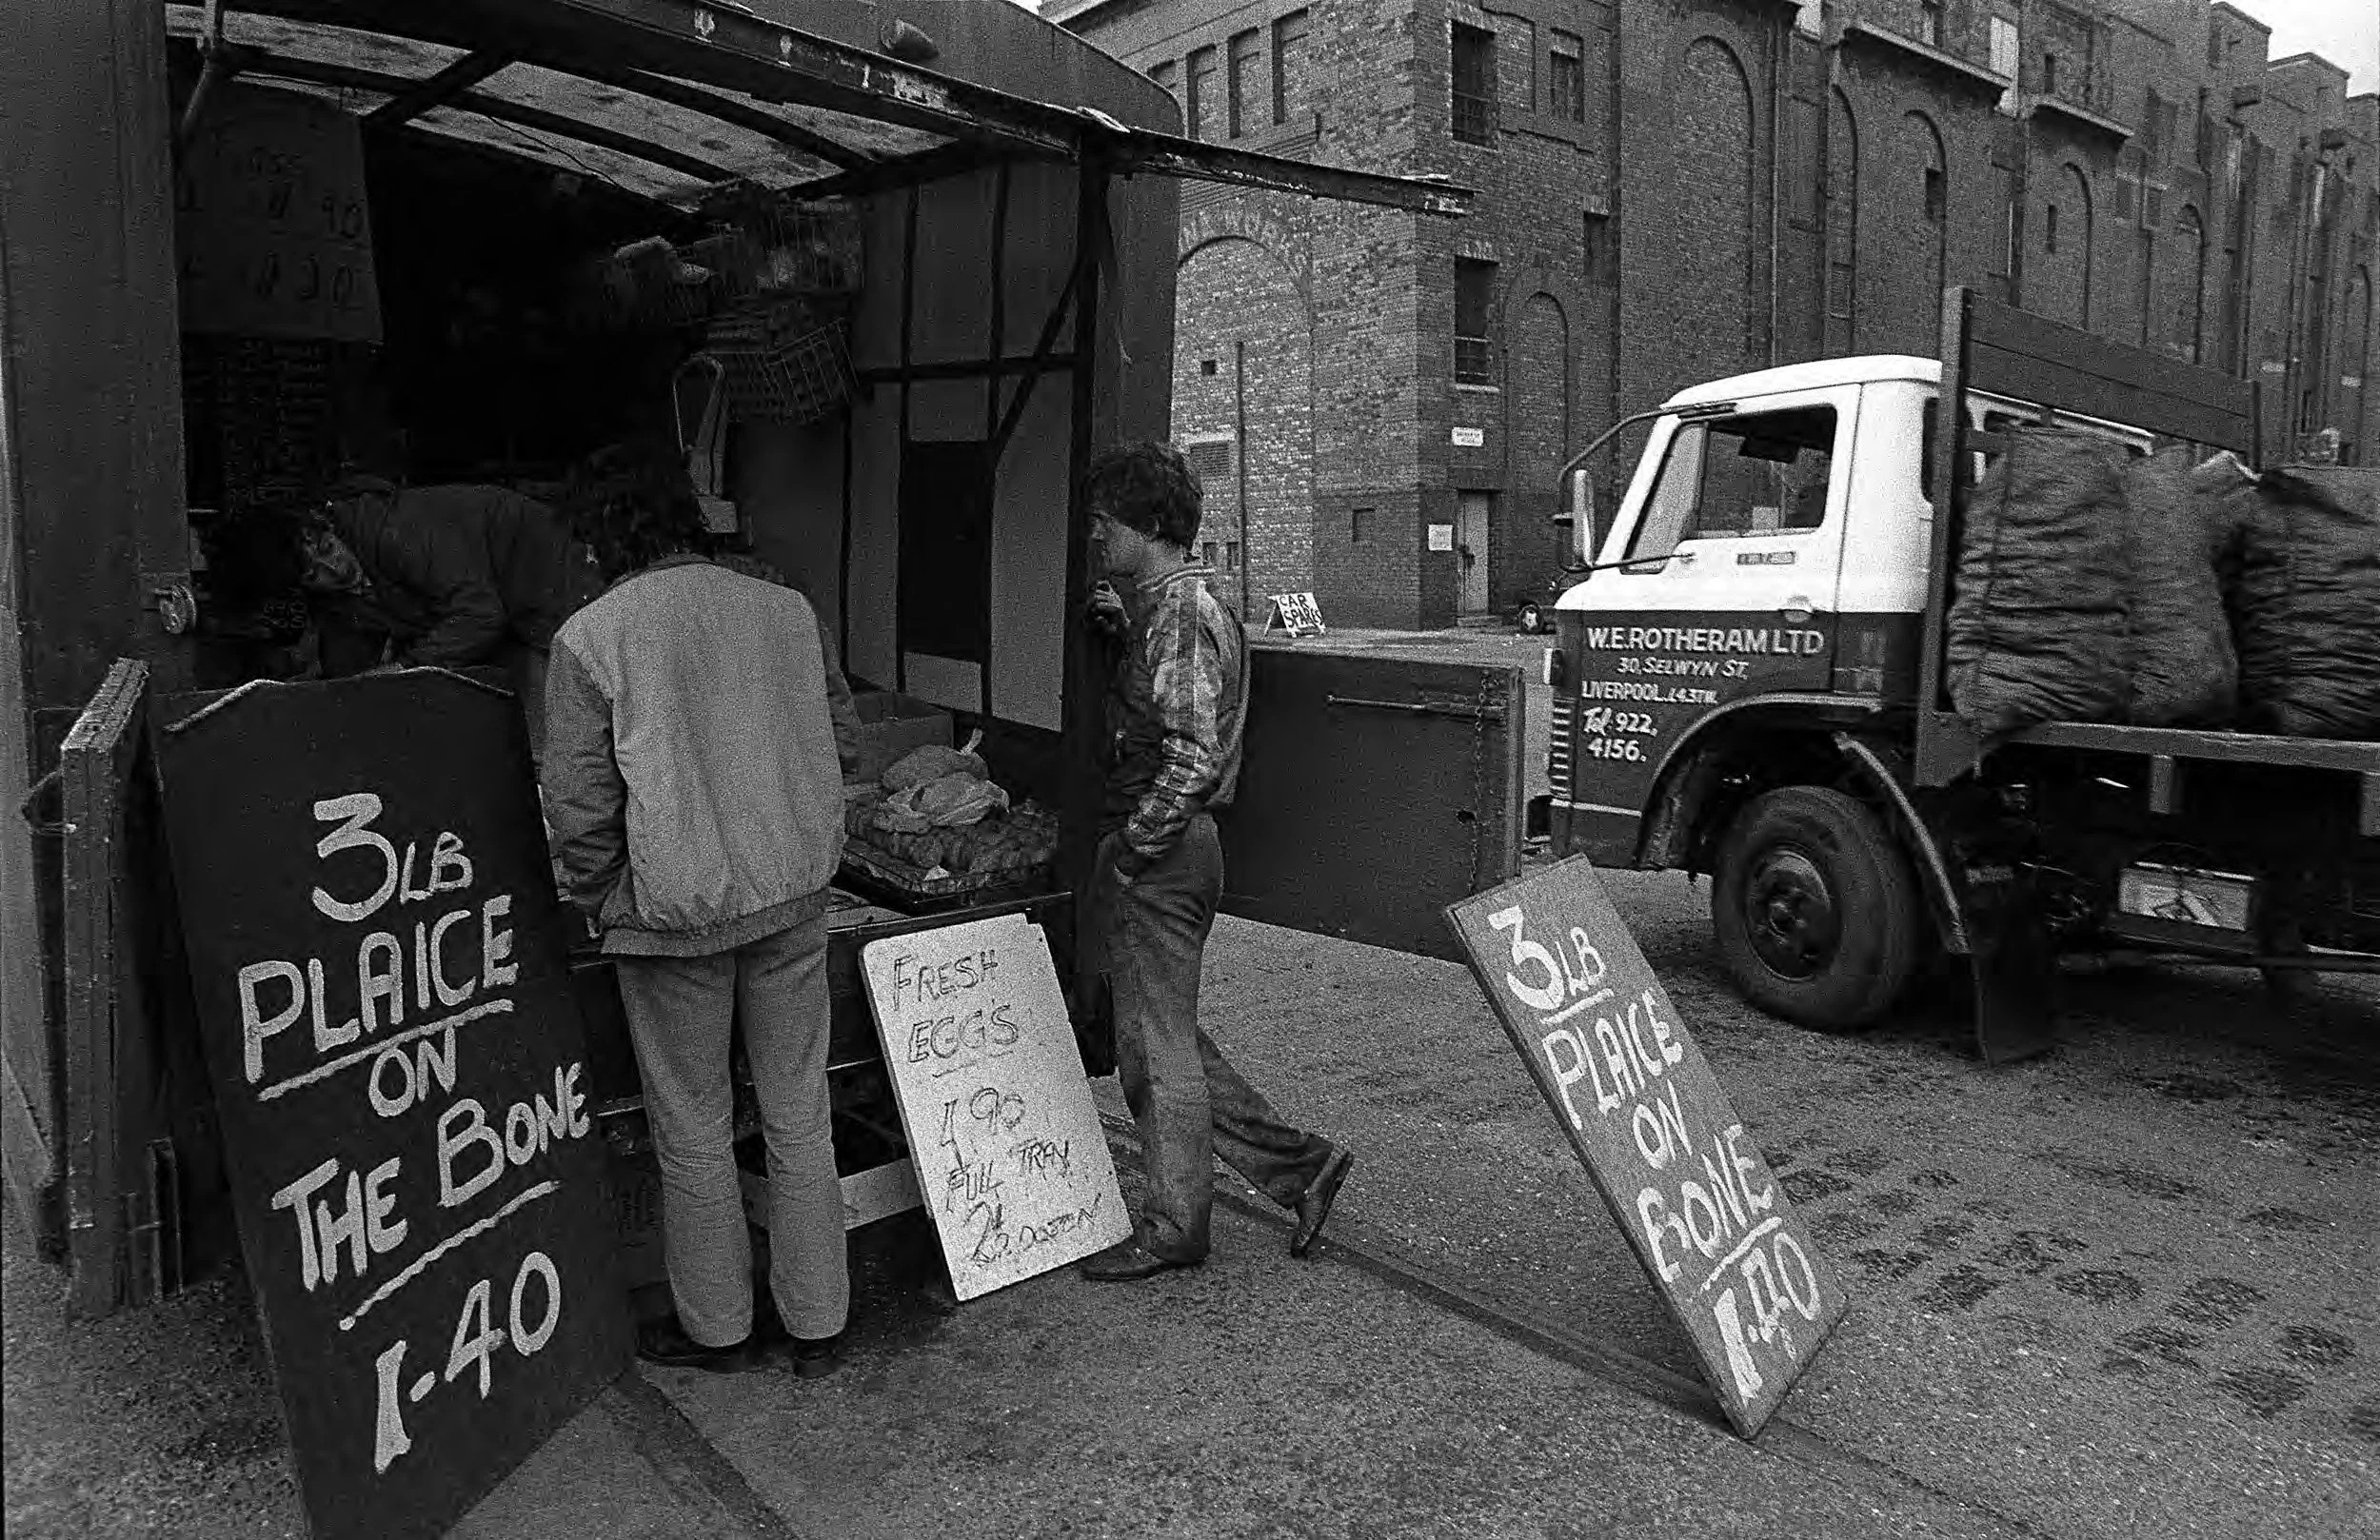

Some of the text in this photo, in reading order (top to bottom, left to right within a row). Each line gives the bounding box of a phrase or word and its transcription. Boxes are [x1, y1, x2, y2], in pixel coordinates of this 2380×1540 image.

[1279, 593, 1309, 609] CAR
[1772, 629, 1825, 655] LTD
[1643, 656, 1718, 679] SELWYN
[236, 893, 520, 1083] PLAICE
[892, 949, 999, 1012] FRESH
[367, 1024, 459, 1116] ON
[1542, 988, 1684, 1131] PLAICE
[1632, 1078, 1694, 1171] ON
[270, 1061, 591, 1291] THE BONE
[945, 1136, 1070, 1214] FULL TRAY
[1636, 1124, 1774, 1284] BONE
[1019, 1193, 1102, 1252] DOZEN
